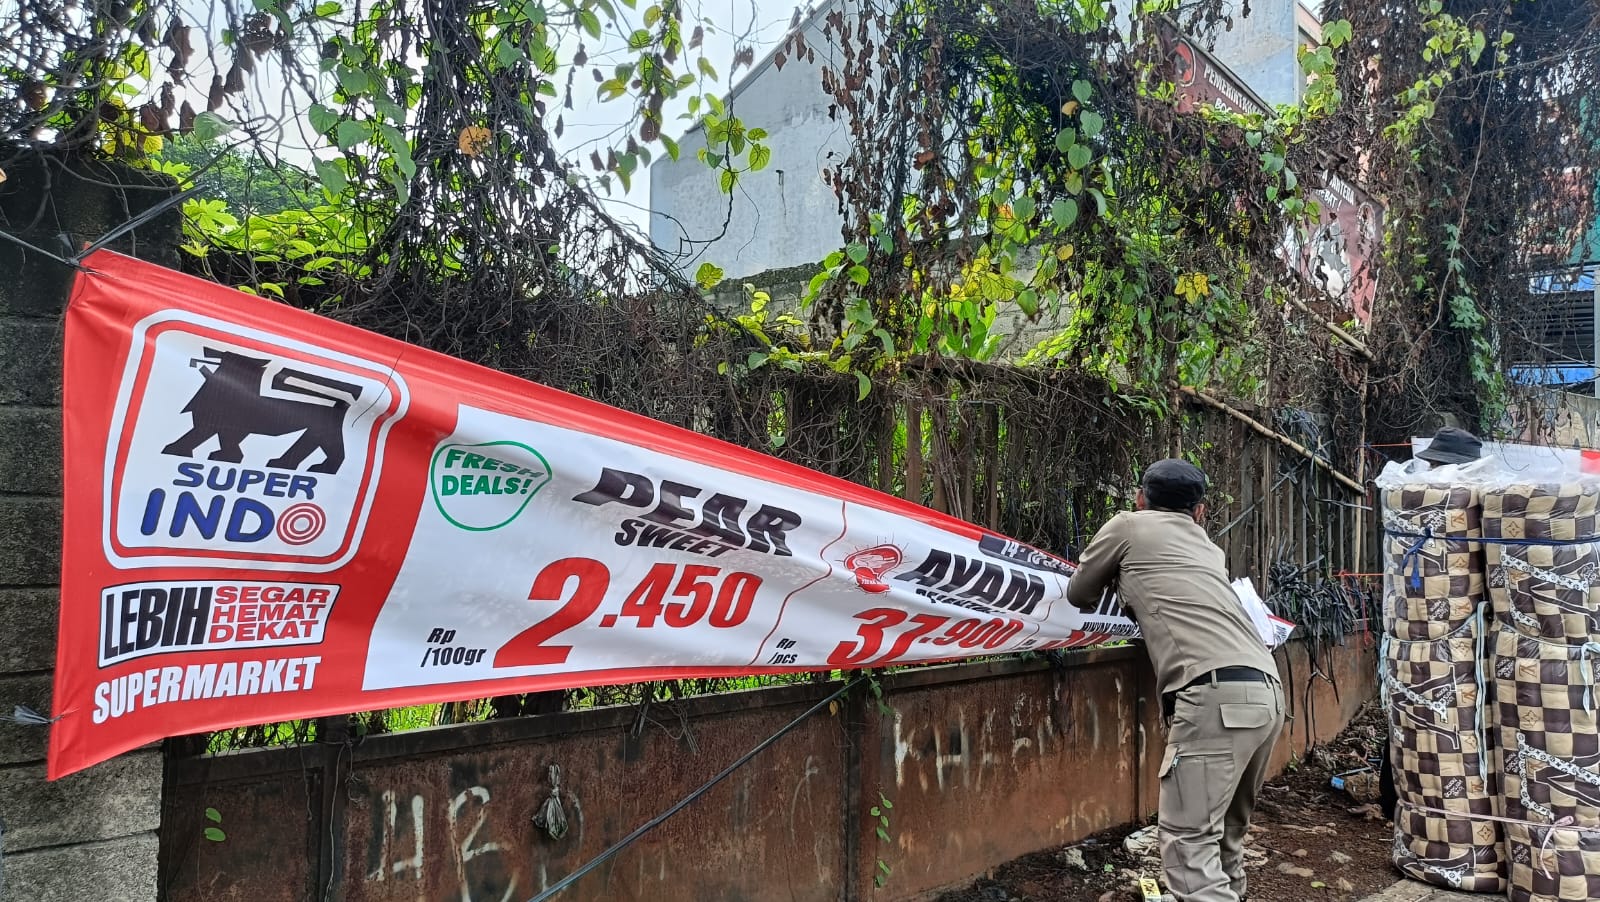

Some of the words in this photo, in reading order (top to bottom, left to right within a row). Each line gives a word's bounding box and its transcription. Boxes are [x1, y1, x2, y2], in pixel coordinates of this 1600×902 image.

[173, 462, 318, 500] SUPER
[444, 448, 546, 479] FRESH
[441, 475, 534, 497] DEALS!
[140, 487, 327, 546] INDO
[571, 466, 802, 557] PEAR
[614, 517, 739, 558] SWEET
[894, 548, 1046, 615] AYAM
[103, 586, 214, 660] LEBIH
[213, 585, 330, 605] SEGAR
[208, 619, 320, 644] DEKAT
[212, 603, 326, 624] HEMAT
[492, 556, 763, 669] 2.450
[427, 627, 457, 647] Rp
[776, 637, 798, 651] Rp
[826, 607, 1025, 668] 37.900
[420, 646, 487, 668] /100gr
[768, 650, 798, 665] /pcs
[92, 656, 322, 725] SUPERMARKET
